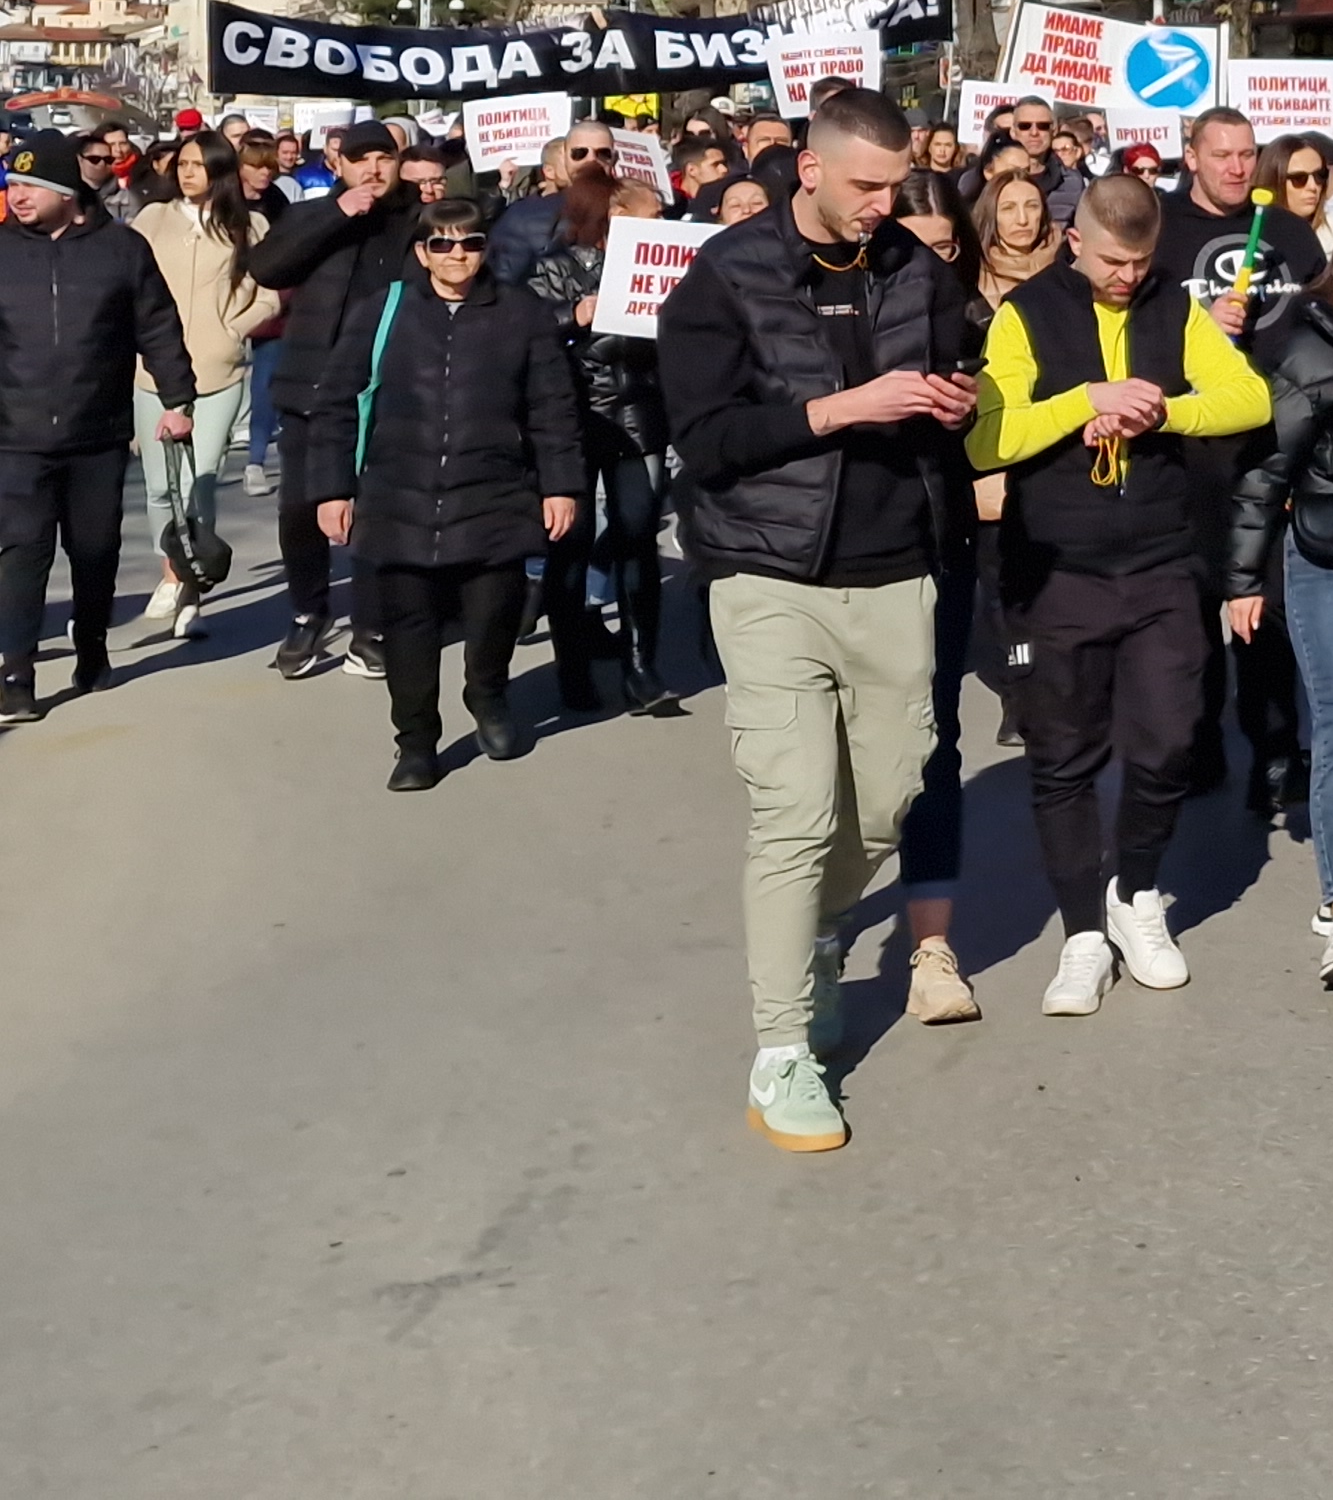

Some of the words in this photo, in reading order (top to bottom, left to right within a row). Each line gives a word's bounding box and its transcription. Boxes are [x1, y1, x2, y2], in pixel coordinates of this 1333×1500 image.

[1044, 11, 1104, 40] ИМАМЕ
[222, 20, 542, 92] СВОБОДА
[560, 28, 636, 73] ЗА
[1041, 34, 1099, 62] ПРАВО,
[782, 62, 816, 79] ИМАТ
[820, 58, 864, 76] ПРАВО
[1020, 53, 1047, 75] ДА
[1051, 57, 1113, 85] ИМАМЕ
[786, 82, 808, 102] НА
[1248, 76, 1331, 95] ПОЛИТИЦИ,
[1248, 97, 1265, 111] НЕ
[1267, 95, 1331, 112] УБИВАЙТЕ
[478, 107, 550, 127] ПОЛИТИЦИ,
[973, 109, 985, 120] НЕ
[492, 123, 551, 140] УБИВАЙТЕ
[1116, 126, 1170, 142] ПРОТЕСТ
[630, 273, 655, 294] НЕ
